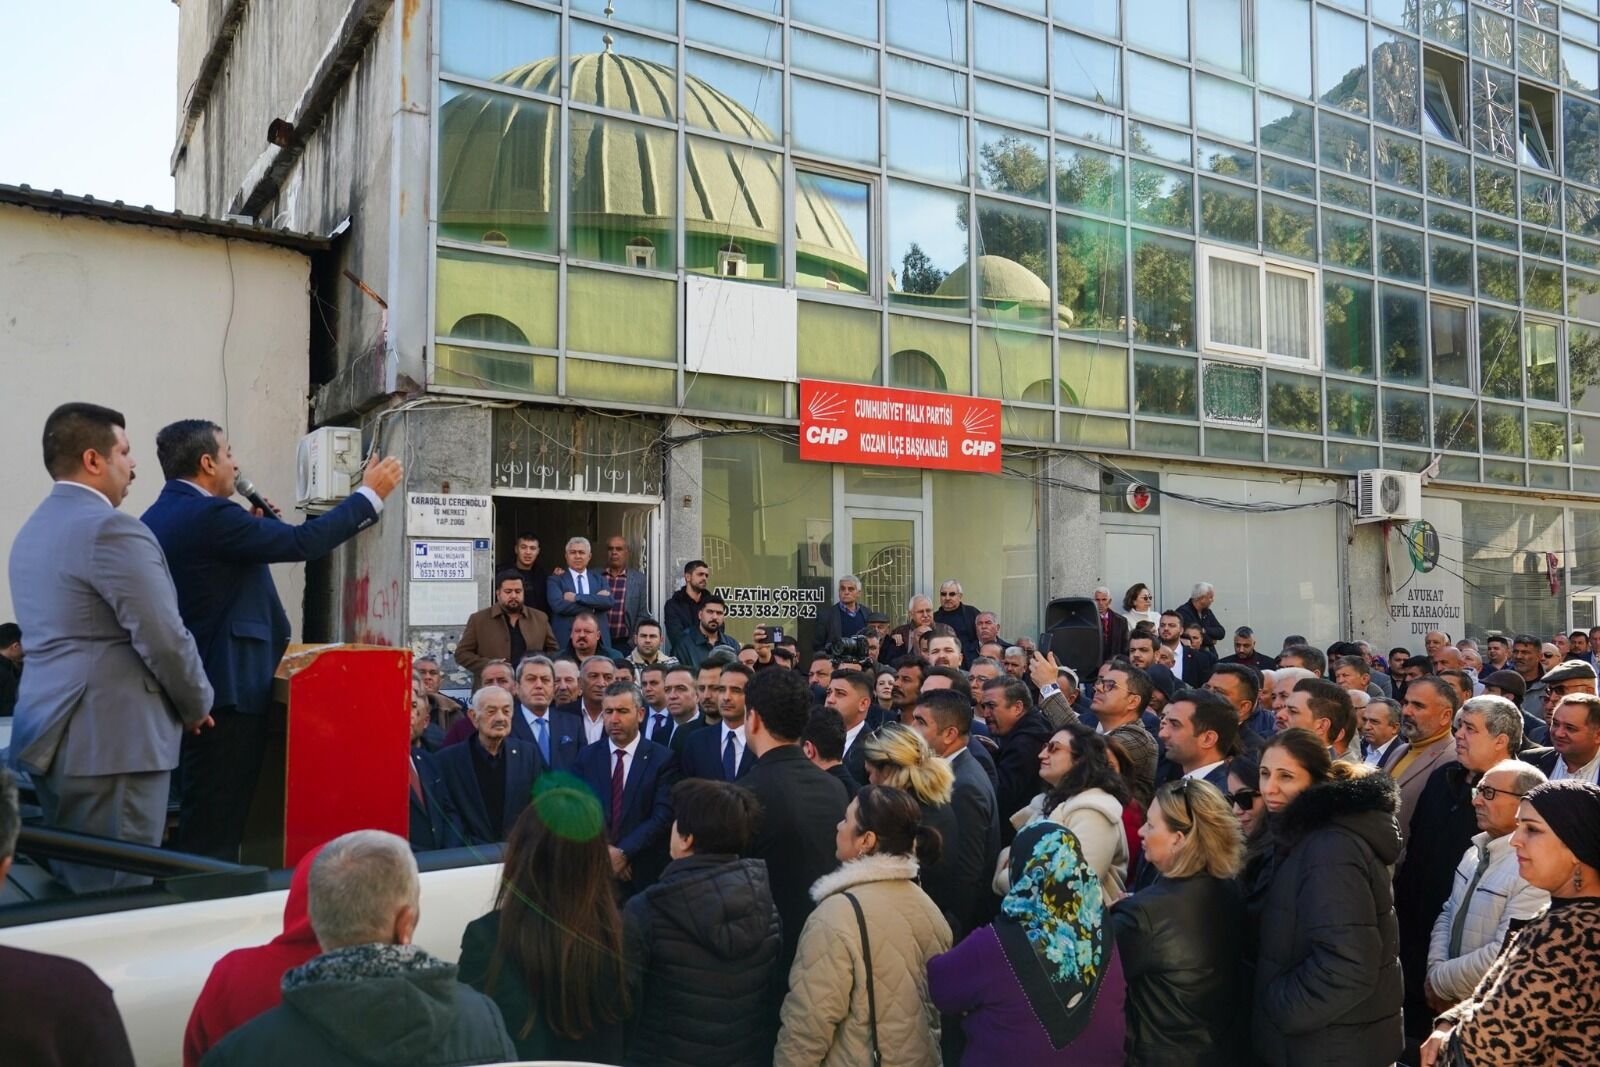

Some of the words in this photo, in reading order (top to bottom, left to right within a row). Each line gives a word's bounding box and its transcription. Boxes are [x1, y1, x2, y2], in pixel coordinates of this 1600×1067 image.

[854, 398, 904, 420] CUMHURİYET
[905, 404, 925, 423] HALK
[926, 404, 953, 426] PARTİSİ
[806, 426, 848, 445] CHP
[860, 433, 886, 453] KOZAN
[887, 431, 904, 459] İLÇE
[905, 437, 948, 460] BAŞKANLIĞI
[961, 439, 996, 457] CHP
[434, 560, 457, 568] Mehmet
[713, 587, 732, 600] AV.
[734, 586, 770, 601] FATİH
[772, 586, 824, 604] ÇÖREKLİ
[1408, 589, 1444, 602] AVUKAT
[723, 604, 753, 617] 0533
[756, 604, 780, 617] 382
[782, 604, 798, 617] 78
[799, 604, 817, 618] 42
[1412, 603, 1460, 619] KARAOĞLU
